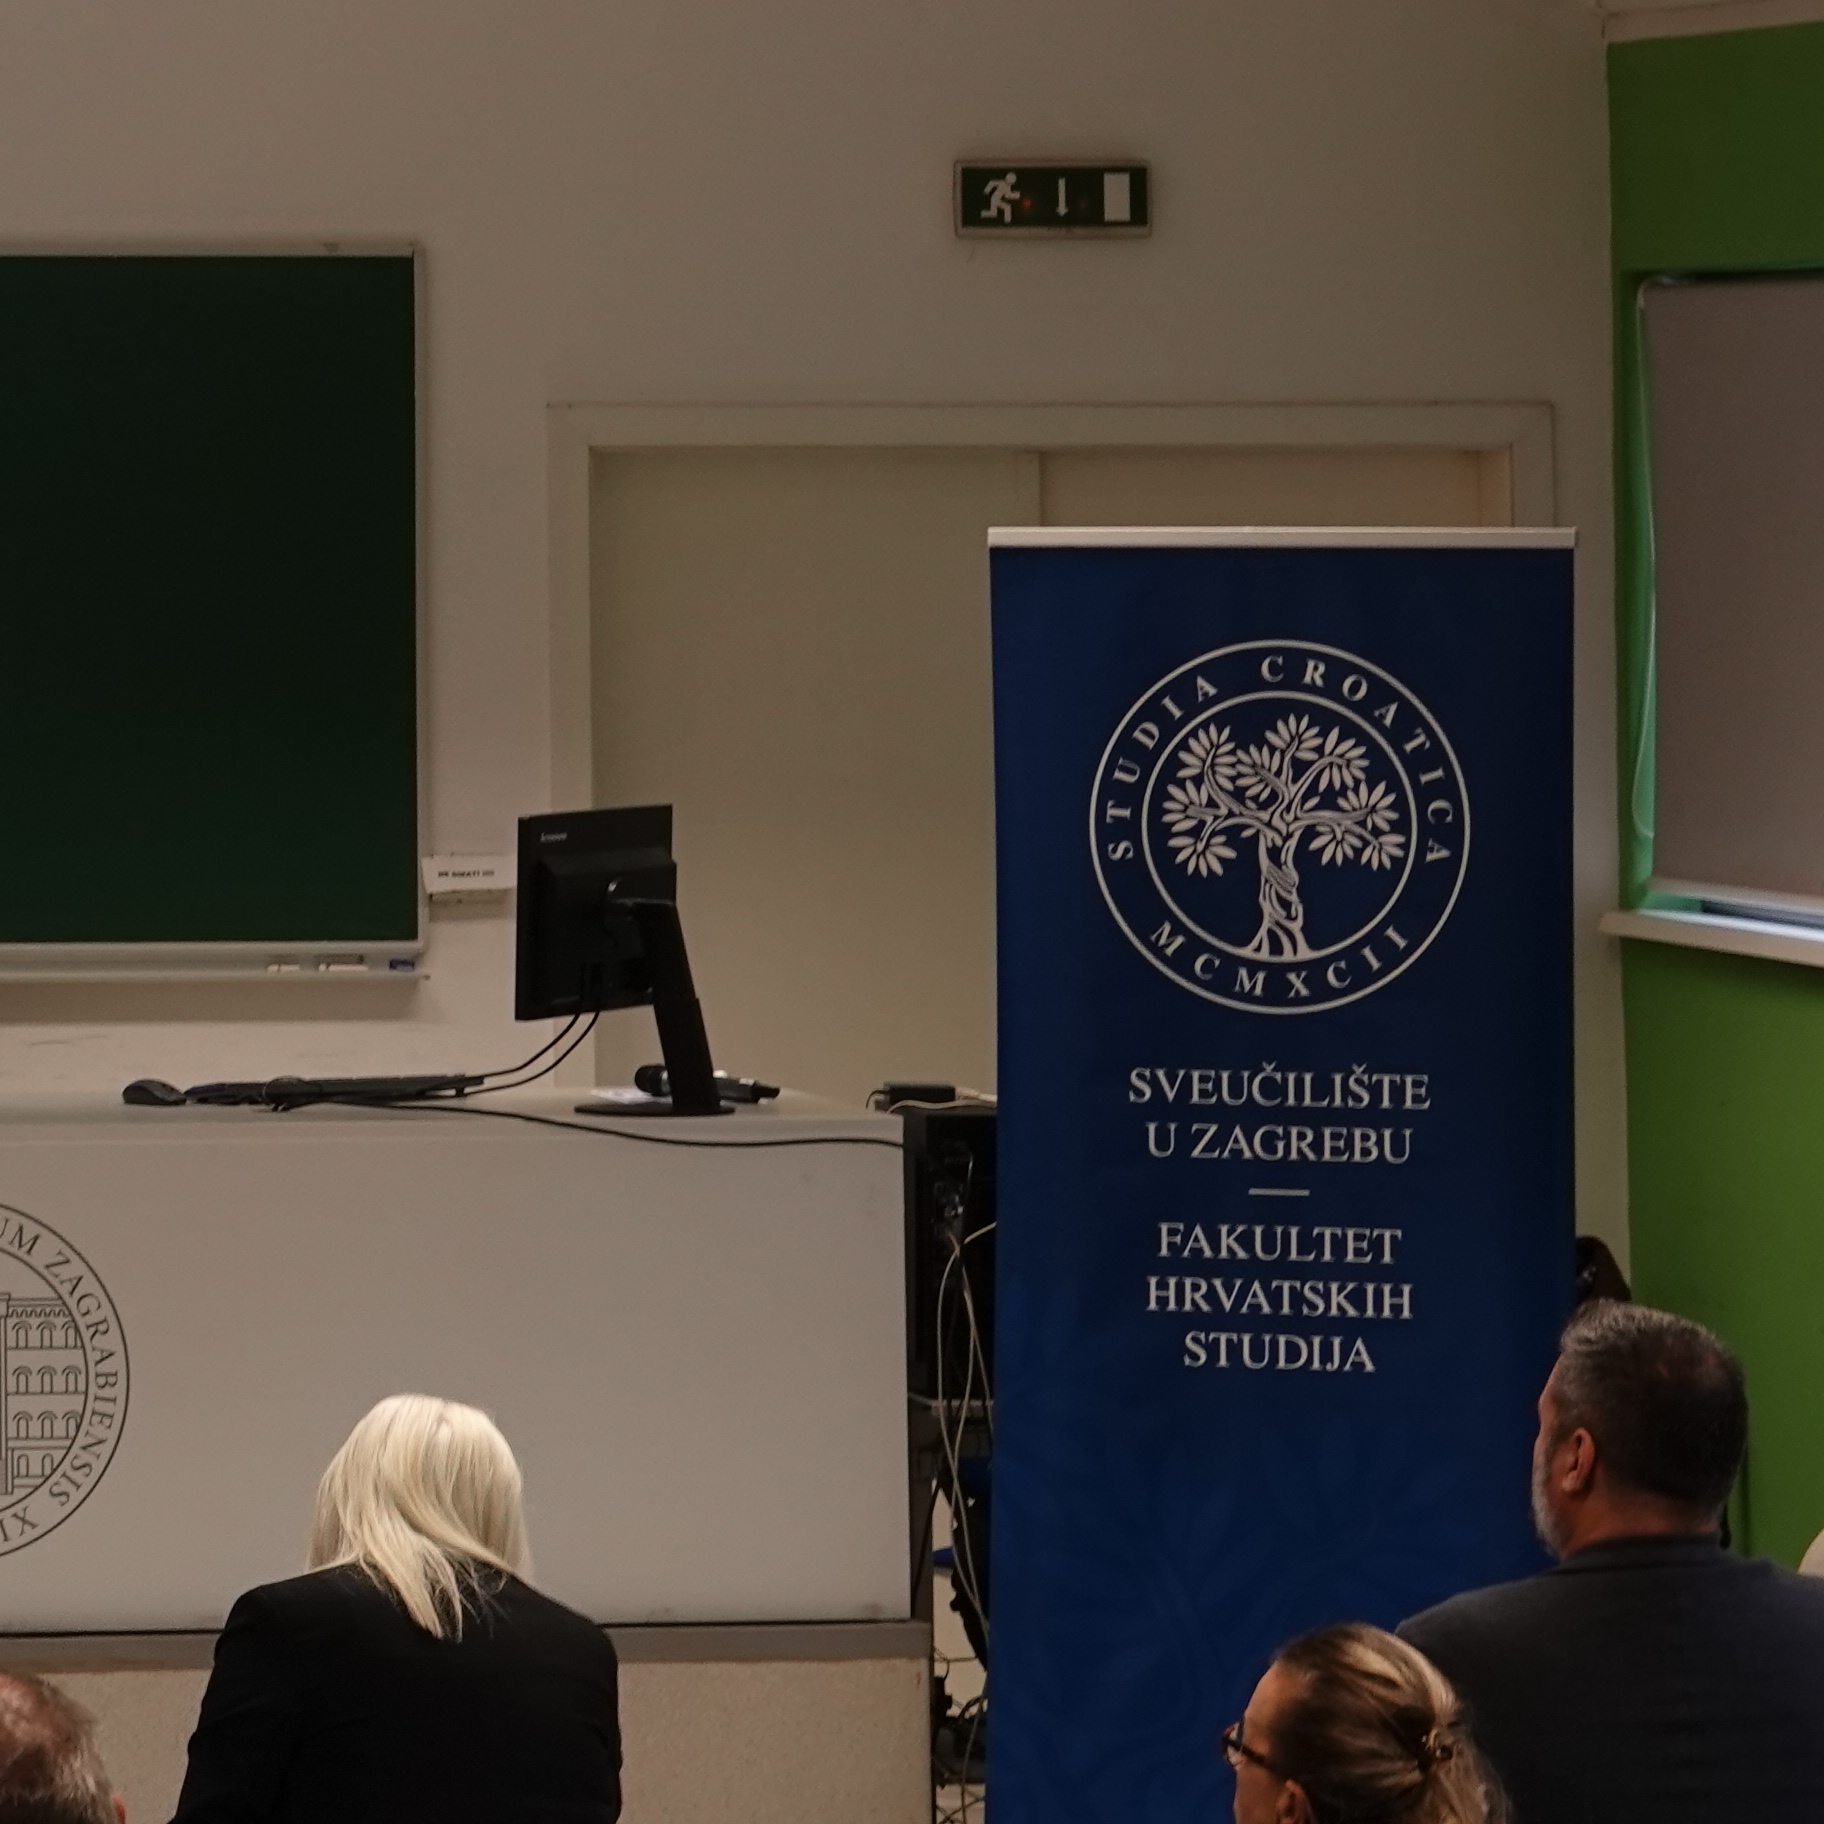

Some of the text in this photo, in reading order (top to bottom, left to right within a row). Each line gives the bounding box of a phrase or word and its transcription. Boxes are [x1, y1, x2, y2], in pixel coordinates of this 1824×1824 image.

[1106, 655, 1451, 863] STUDIA CROATICA
[1150, 921, 1409, 998] MCMXCII
[1128, 1061, 1431, 1110] SVEUČILIŠTE
[1146, 1122, 1413, 1164] U ZAGREBU
[1158, 1222, 1403, 1264] FAKULTET
[1147, 1275, 1412, 1320] HRVATSKIH
[1183, 1330, 1376, 1373] STUDIJA
[44, 1251, 118, 1507] ZAGRABIENSIS
